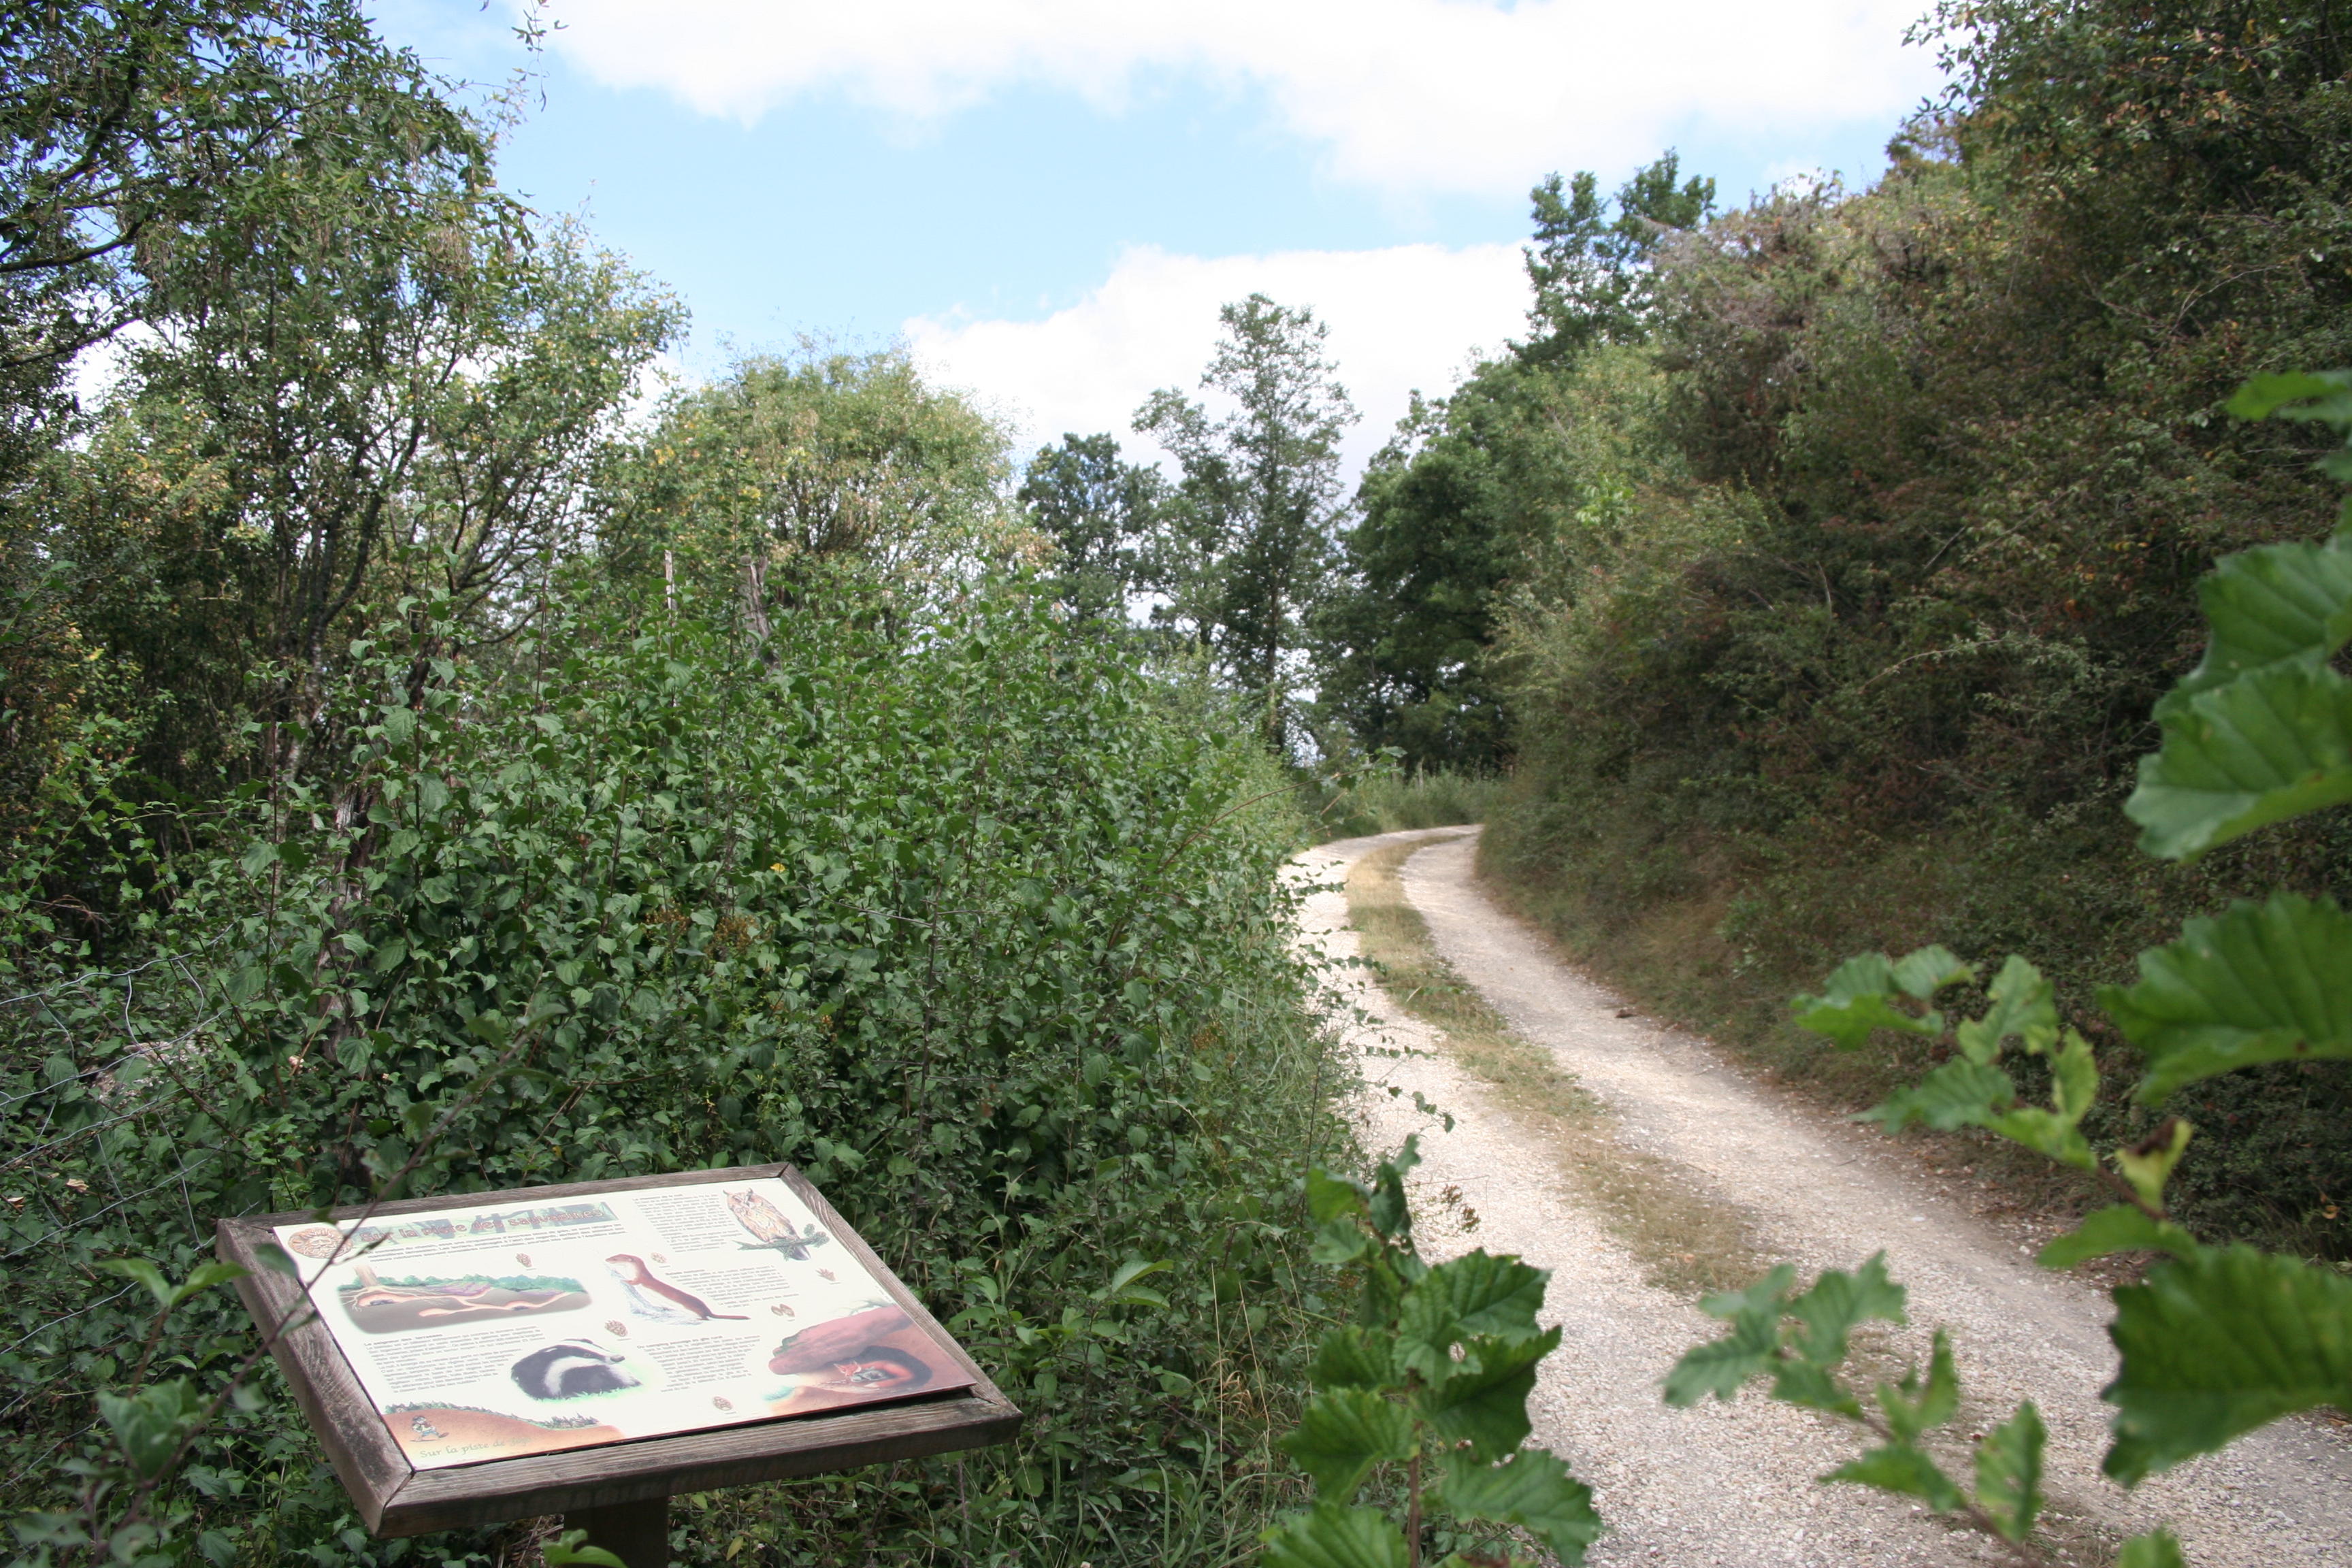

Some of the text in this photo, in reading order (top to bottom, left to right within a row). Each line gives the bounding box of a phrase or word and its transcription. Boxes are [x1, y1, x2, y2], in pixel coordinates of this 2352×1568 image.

[359, 1230, 394, 1242] Sur
[398, 1228, 419, 1239] la
[421, 1224, 468, 1236] piste
[471, 1219, 504, 1230] des
[420, 1449, 442, 1458] Sur
[446, 1445, 458, 1454] la
[461, 1442, 489, 1455] piste
[493, 1438, 506, 1448] de
